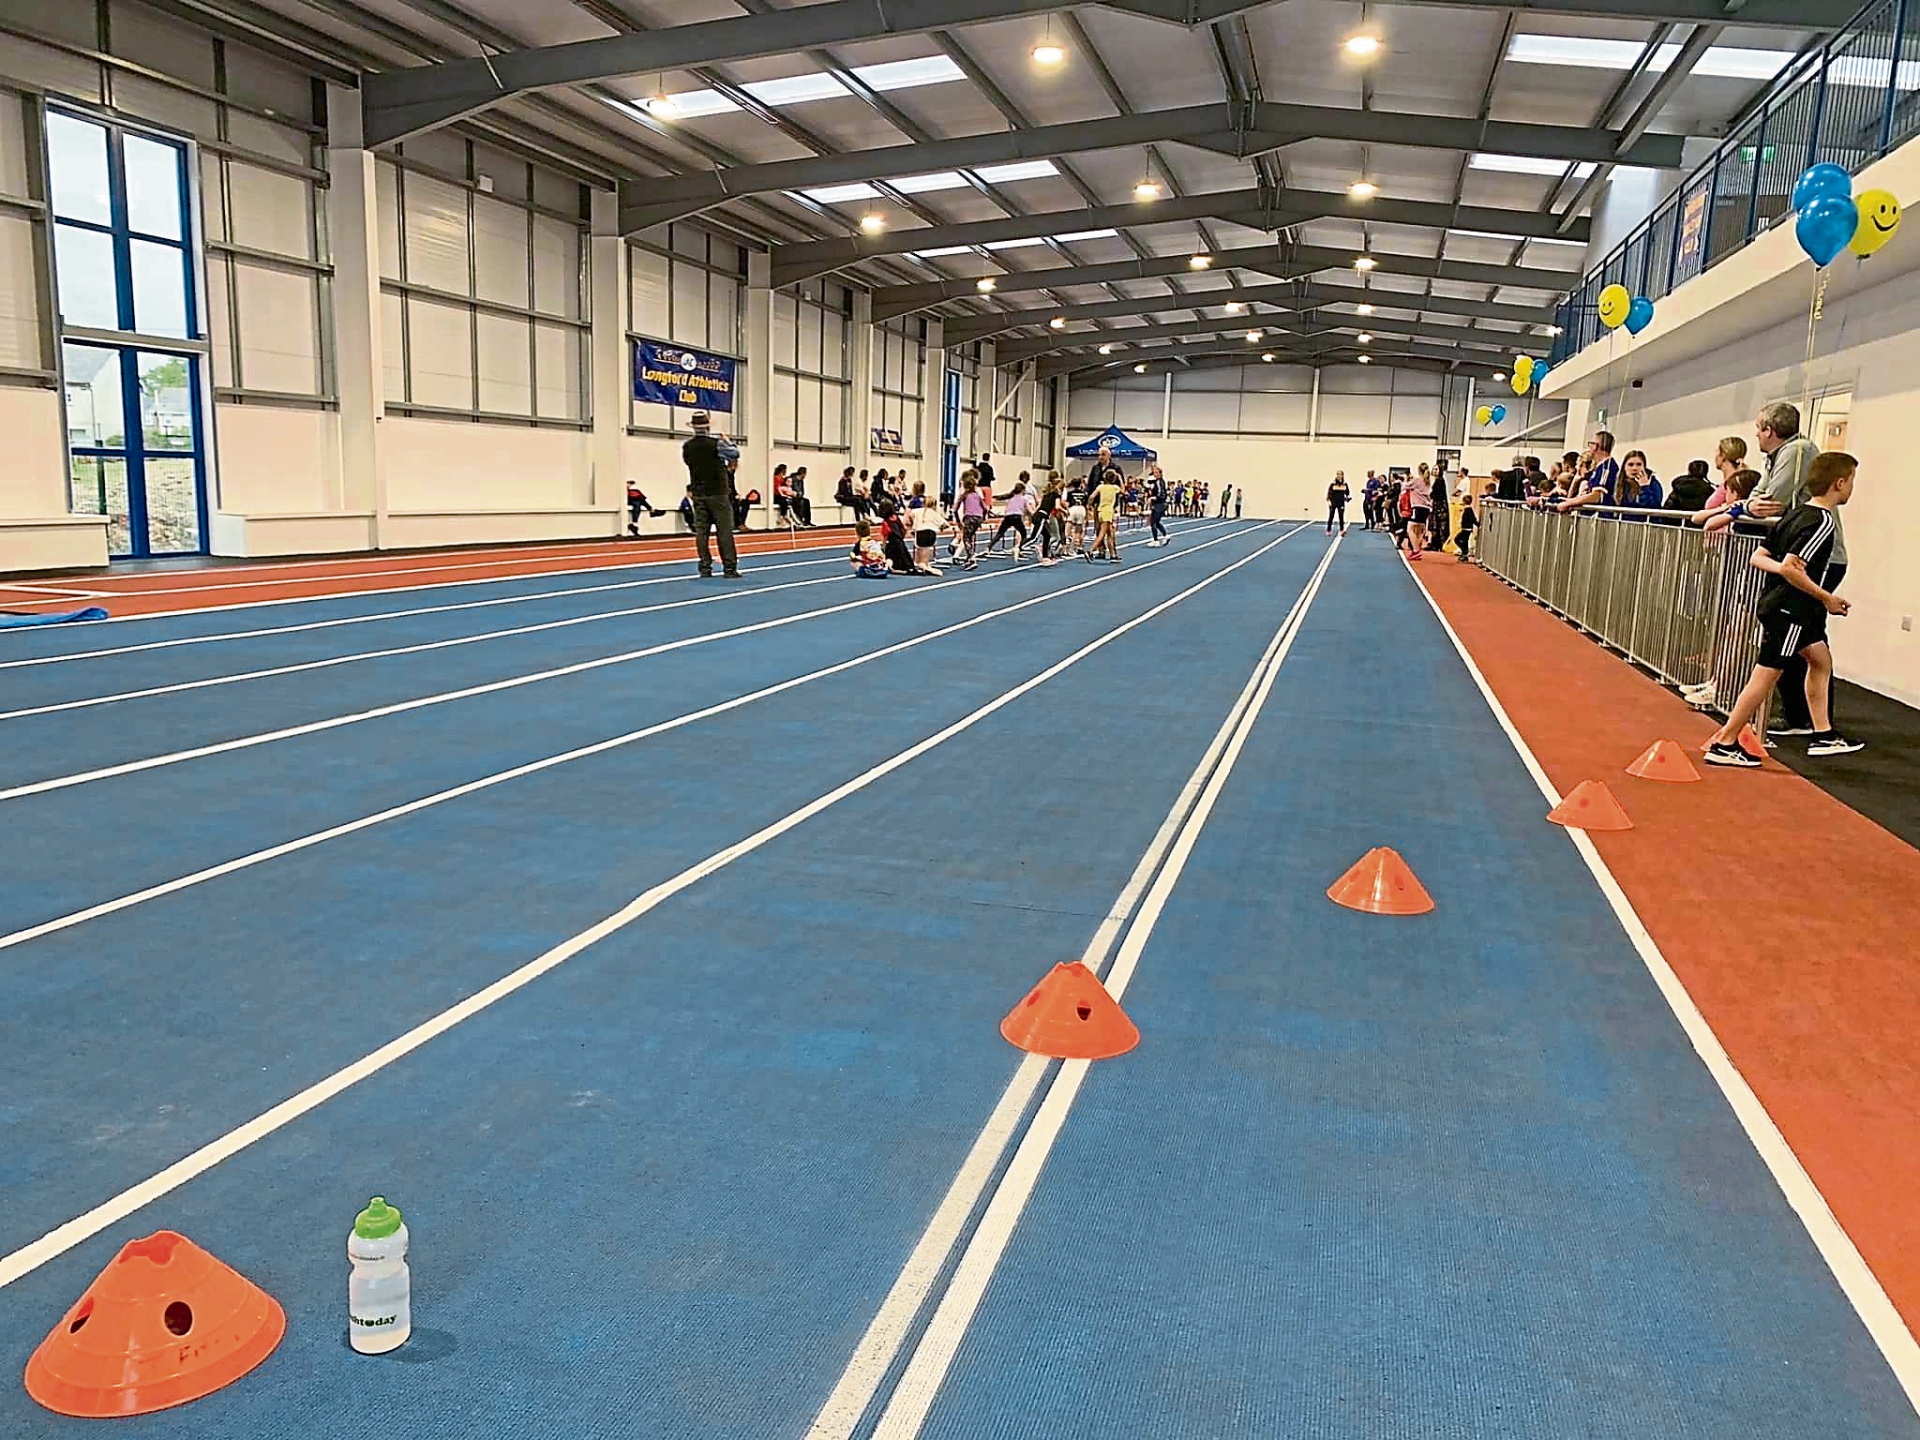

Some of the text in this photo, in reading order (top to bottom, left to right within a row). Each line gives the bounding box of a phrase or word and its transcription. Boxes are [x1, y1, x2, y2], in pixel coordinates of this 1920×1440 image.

[642, 366, 730, 392] Longford Athletics
[679, 389, 698, 404] Club
